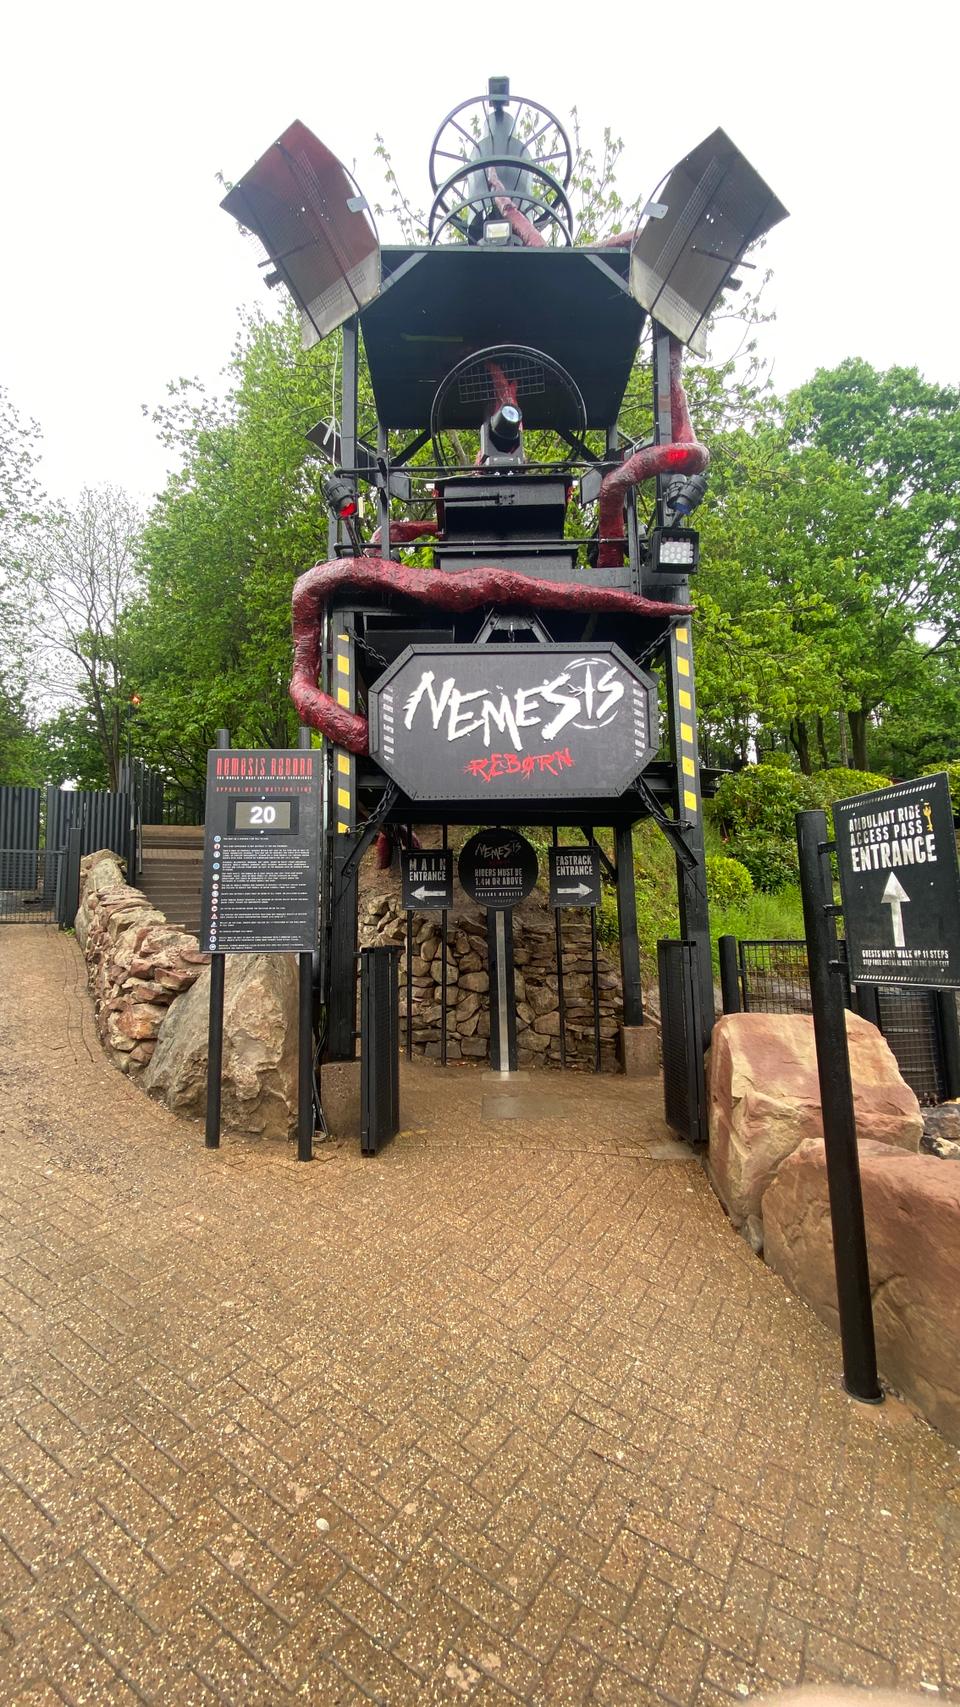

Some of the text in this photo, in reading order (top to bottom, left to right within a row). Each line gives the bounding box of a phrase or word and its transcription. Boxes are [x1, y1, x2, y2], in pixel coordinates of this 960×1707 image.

[403, 658, 625, 752] NEMESIS
[250, 806, 276, 824] 20
[849, 804, 921, 832] AMBULANT RIDE
[850, 820, 923, 847] ACCESS PASS
[851, 833, 938, 872] ENTRANCE
[409, 858, 447, 871] MAIN
[555, 855, 592, 866] FASTRACK
[409, 871, 447, 881] ENTRANCE
[475, 868, 497, 877] RIDERS
[497, 868, 514, 877] MUST
[556, 865, 593, 876] ENTRANCE
[502, 876, 523, 886] ABOVE
[929, 950, 949, 959] STEPS
